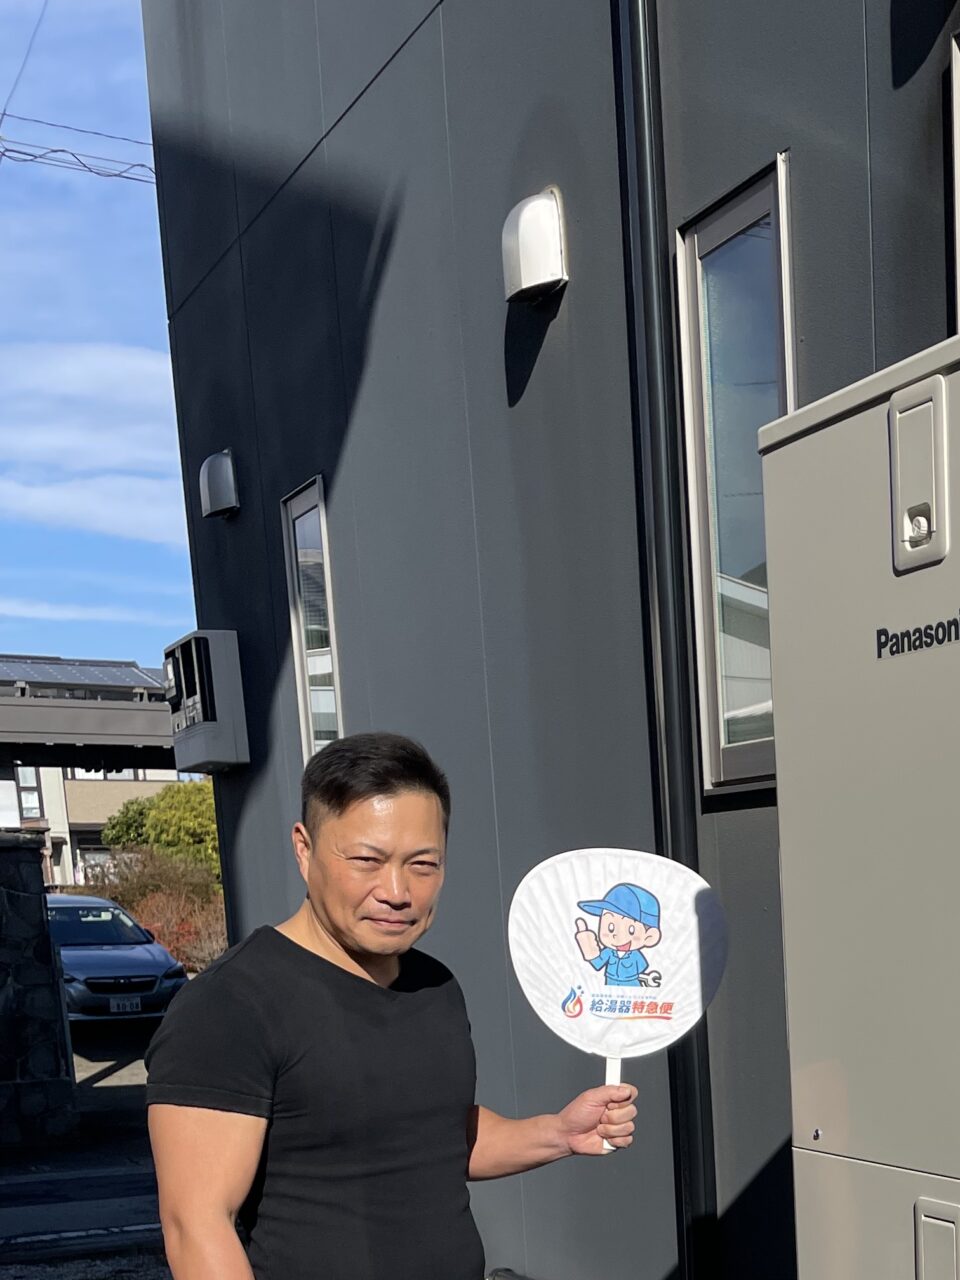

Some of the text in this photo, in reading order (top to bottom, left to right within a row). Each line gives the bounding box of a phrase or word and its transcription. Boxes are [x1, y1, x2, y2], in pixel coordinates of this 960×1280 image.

[590, 998, 674, 1015] 給湯器特急便
